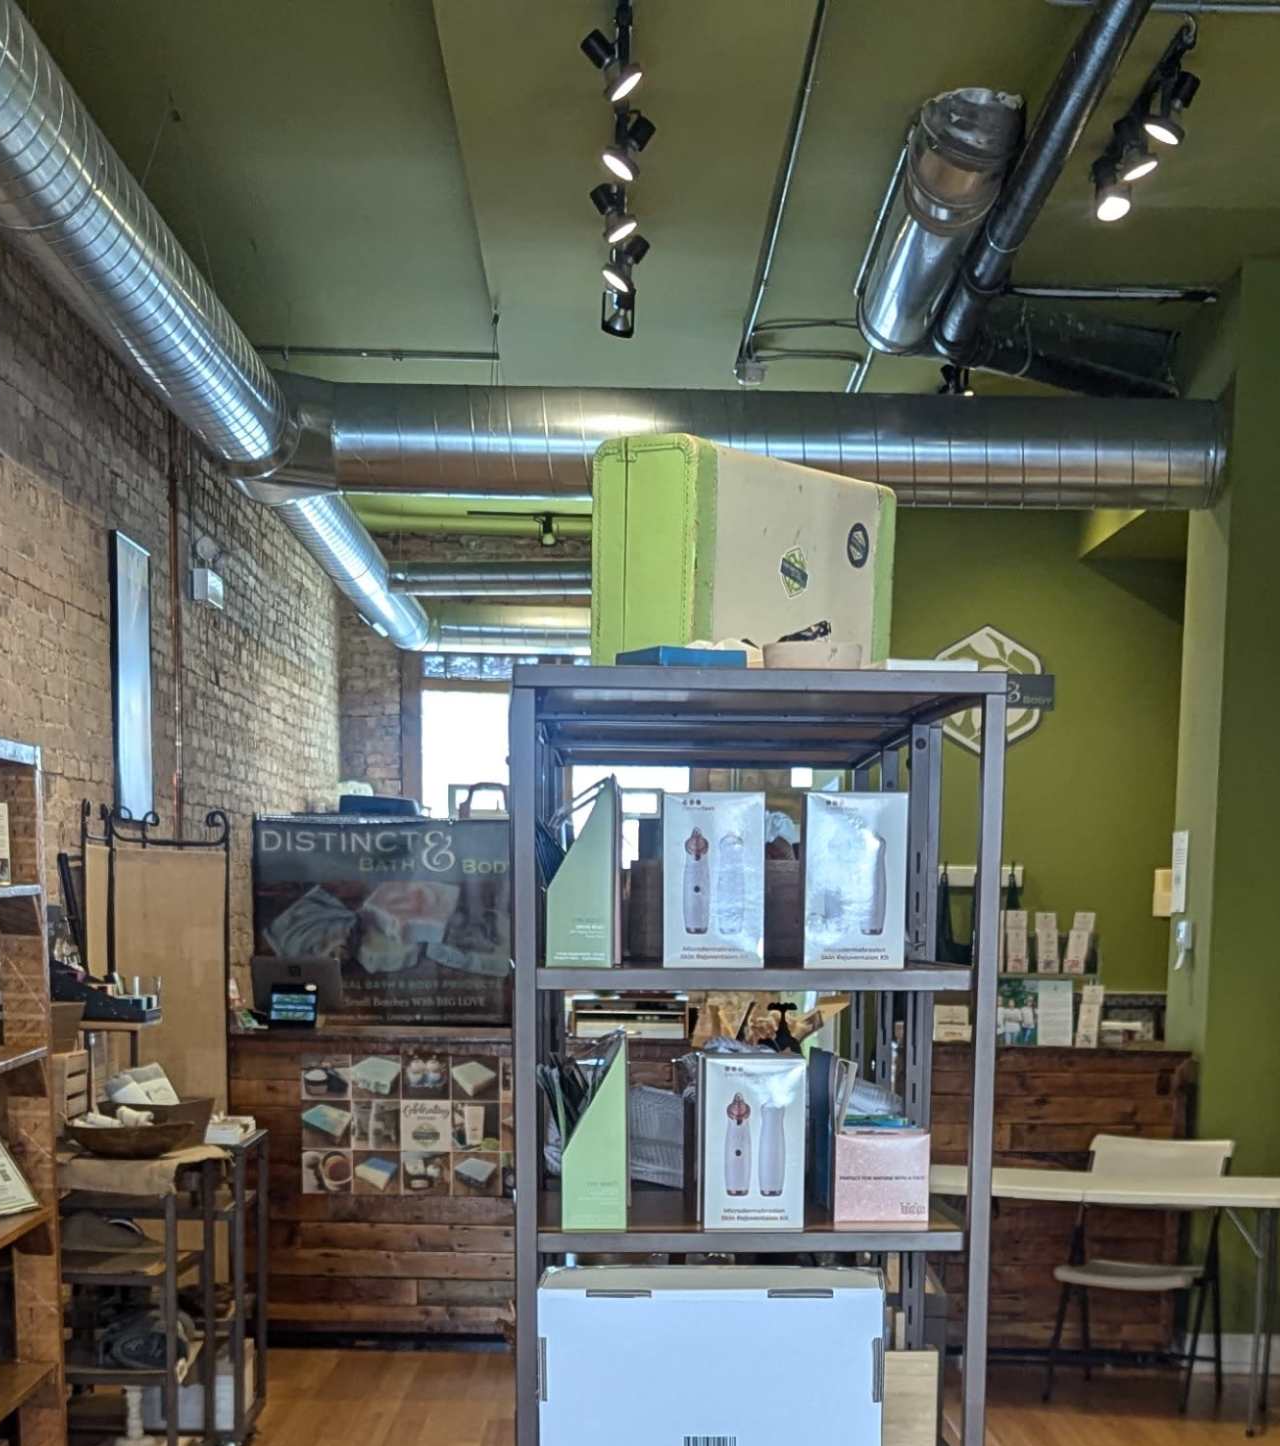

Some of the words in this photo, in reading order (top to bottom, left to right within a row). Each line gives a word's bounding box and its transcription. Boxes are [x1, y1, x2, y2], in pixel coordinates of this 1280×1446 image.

[259, 830, 421, 852] DISTINCT
[422, 831, 456, 872] &
[359, 858, 416, 872] BATH
[462, 859, 508, 875] BOD
